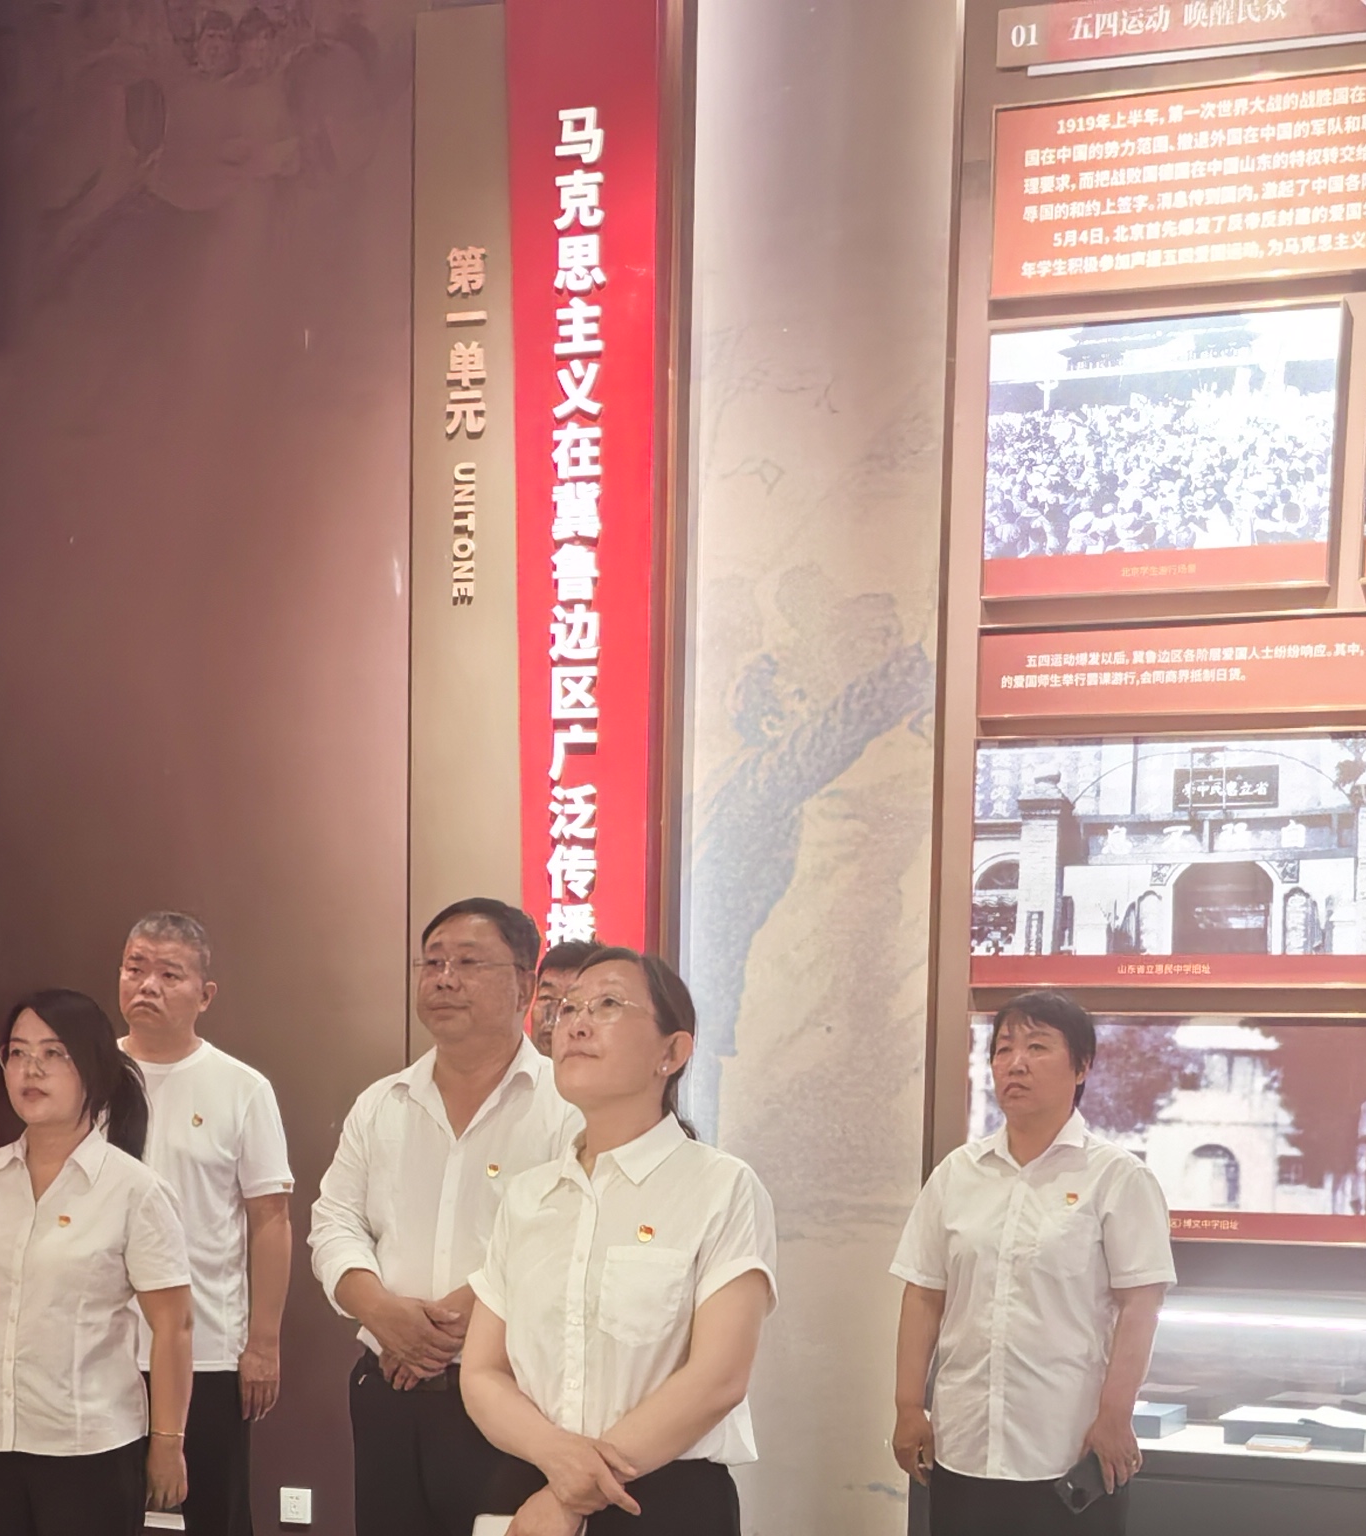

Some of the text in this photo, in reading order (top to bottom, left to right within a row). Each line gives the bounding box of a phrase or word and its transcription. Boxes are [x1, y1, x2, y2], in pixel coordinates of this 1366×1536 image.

[1010, 24, 1038, 47] 01
[1069, 4, 1170, 41] 五四运动
[446, 246, 487, 436] 第一单元
[545, 107, 605, 950] 马克思主义在冀鲁边区广泛传播
